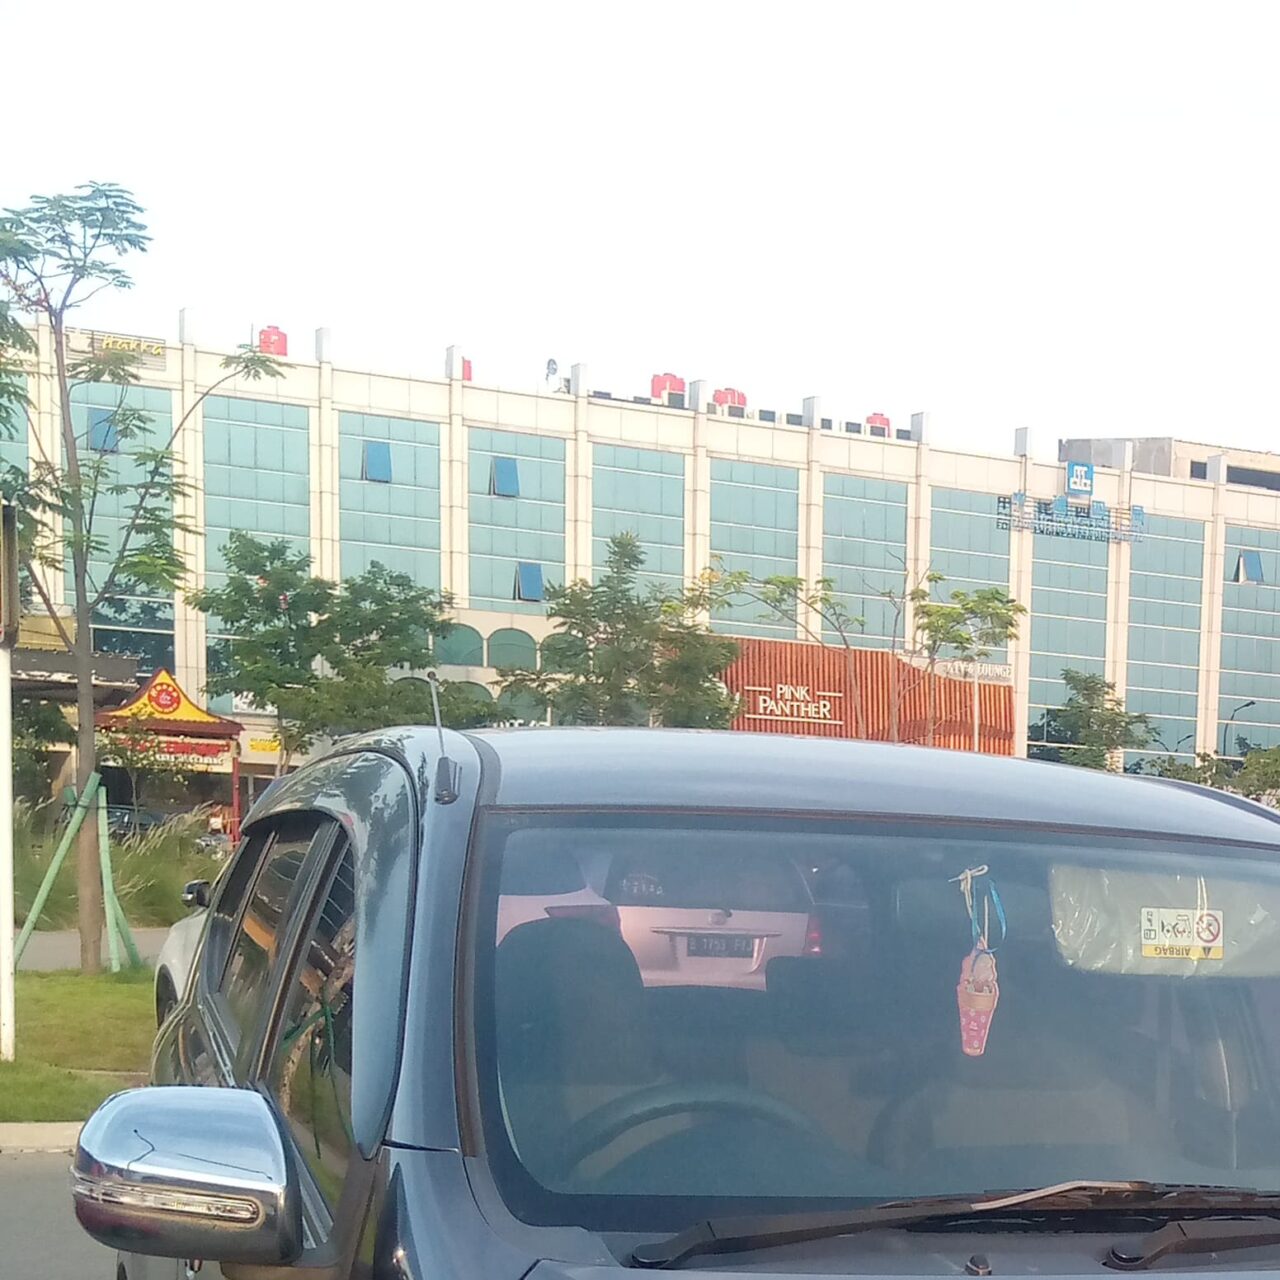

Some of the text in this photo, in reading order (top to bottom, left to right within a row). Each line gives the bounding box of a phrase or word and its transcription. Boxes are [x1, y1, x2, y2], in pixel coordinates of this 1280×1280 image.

[776, 684, 811, 701] PINK
[758, 695, 832, 718] PANTHER
[1154, 946, 1191, 956] AIRBAG
